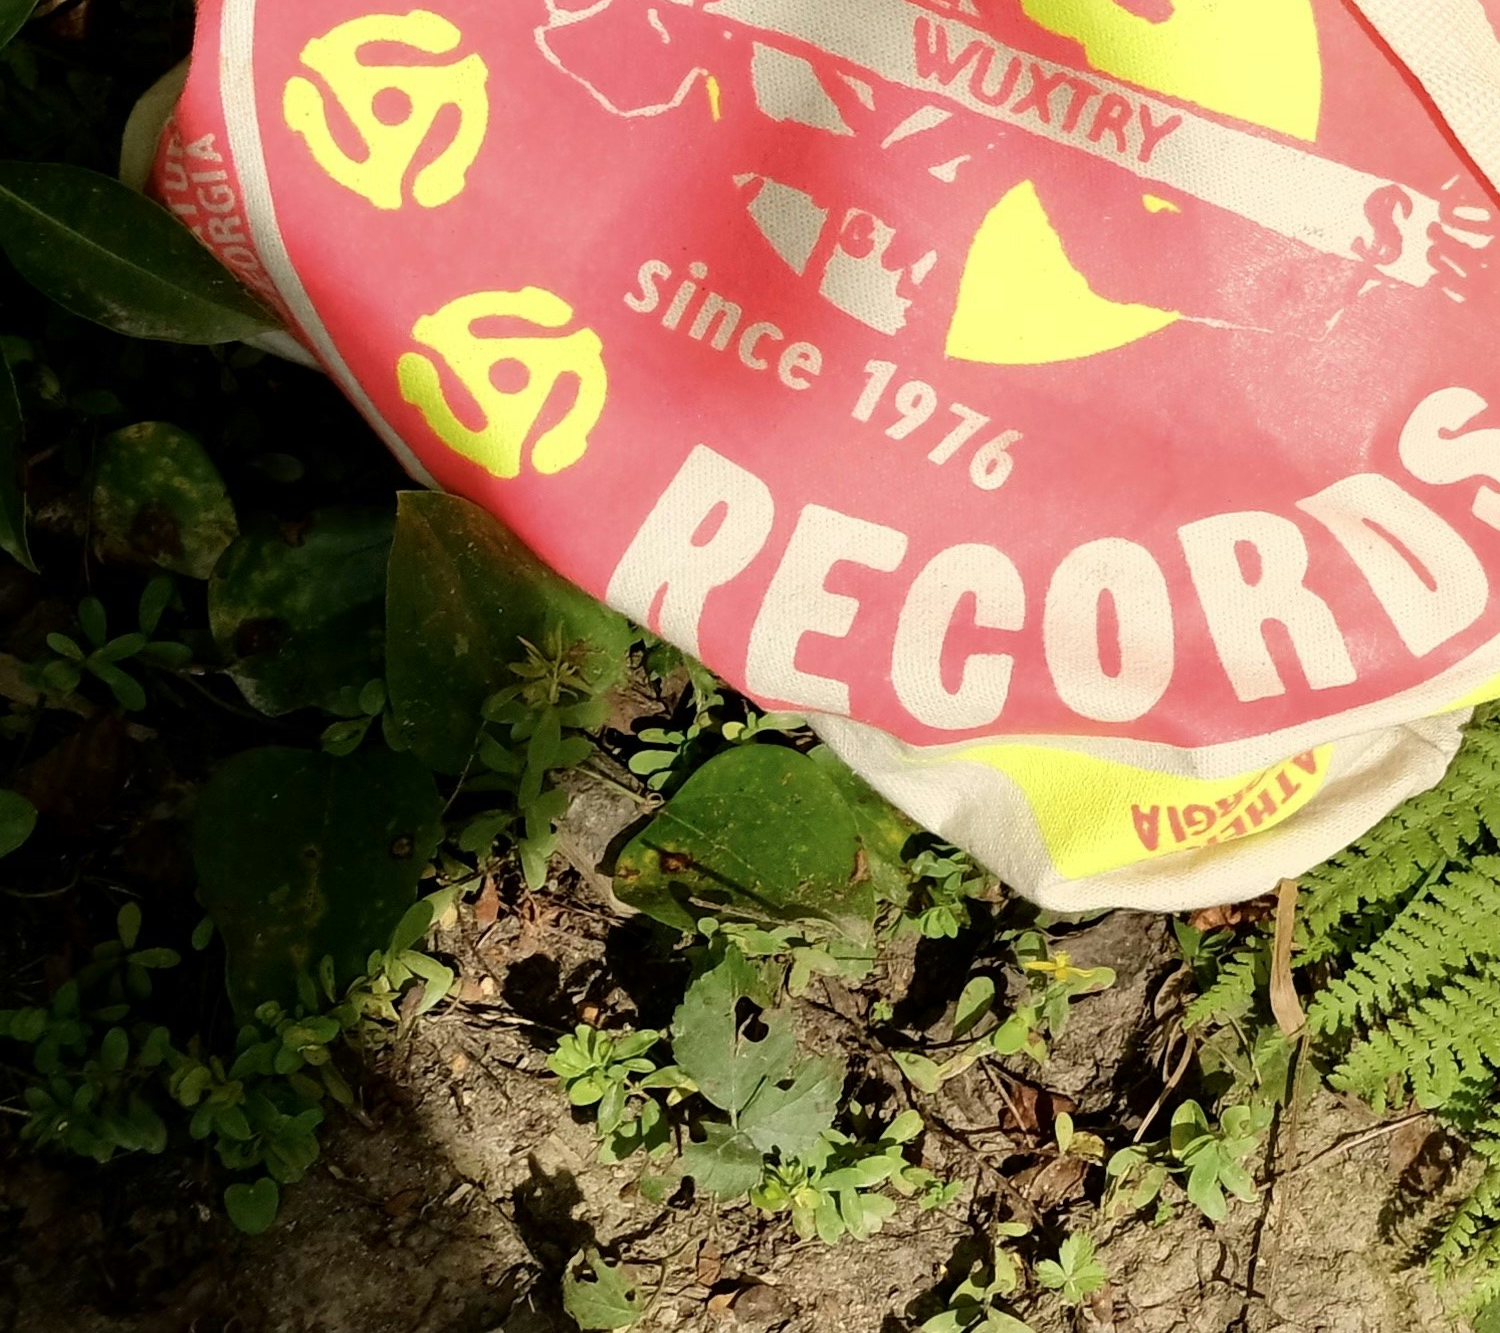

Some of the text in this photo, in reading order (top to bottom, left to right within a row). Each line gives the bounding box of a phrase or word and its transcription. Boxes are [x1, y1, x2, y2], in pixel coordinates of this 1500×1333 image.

[913, 16, 1182, 164] WUXTRY
[624, 258, 1025, 492] since 1976
